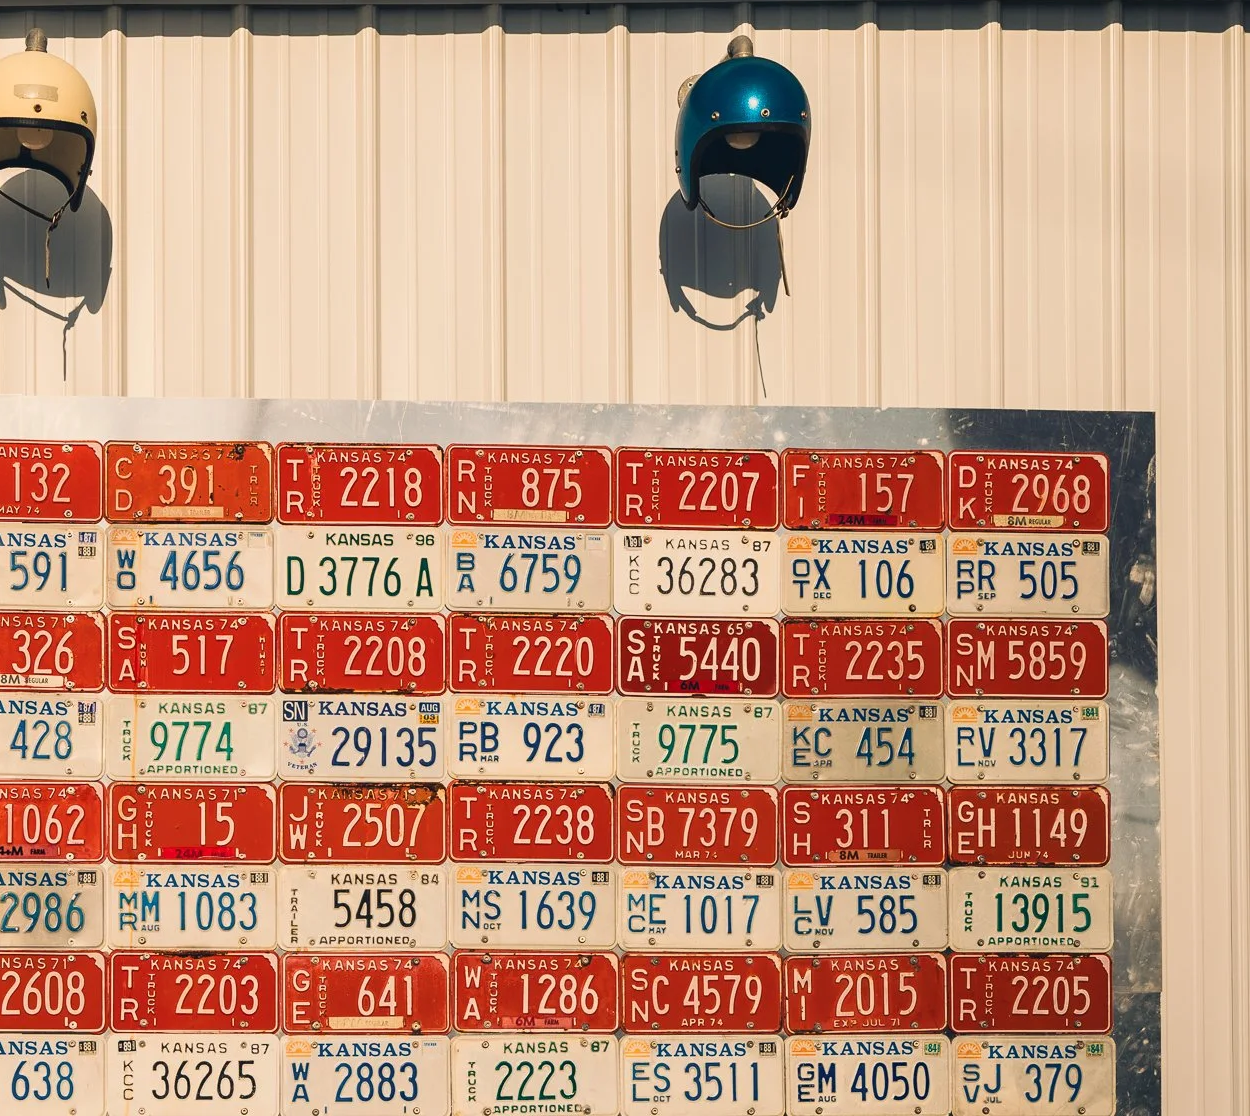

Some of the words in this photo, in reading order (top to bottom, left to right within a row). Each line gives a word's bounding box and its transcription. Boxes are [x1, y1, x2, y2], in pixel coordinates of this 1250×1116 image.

[158, 465, 214, 504] 391
[340, 468, 422, 507] 2218
[522, 468, 582, 508] 875
[679, 472, 760, 511] 2207
[859, 473, 914, 512] 157
[1011, 474, 1090, 514] 2968
[326, 534, 393, 545] KANSAS
[416, 535, 434, 545] 96
[1008, 517, 1026, 525] 8M
[160, 551, 244, 590] 4656
[287, 556, 305, 595] D
[319, 557, 400, 596] 3776
[416, 558, 433, 597] A
[500, 554, 581, 593] 6759
[657, 557, 759, 596] 36283
[12, 631, 74, 674] 326
[172, 635, 234, 675] 517
[344, 636, 426, 676] 2208
[513, 637, 593, 676] 2220
[679, 637, 760, 681] 5440
[846, 641, 925, 680] 2235
[159, 703, 225, 714] KANSAS
[248, 704, 267, 714] 87
[318, 701, 407, 716] KANSAS
[421, 704, 438, 712] AUG
[151, 721, 233, 761] 9774
[332, 727, 436, 767] 29135
[658, 725, 739, 763] 9775
[147, 765, 238, 774] APPORTIONED
[287, 761, 317, 770] VETERAN
[656, 768, 743, 777] APPORTIONED
[5, 803, 85, 845] 1062
[199, 802, 234, 845] 15
[343, 803, 426, 847] 2507
[513, 805, 594, 844] 2238
[836, 809, 889, 848] 311
[840, 851, 859, 860] 8M
[1009, 851, 1030, 859] JUN
[331, 874, 397, 885] KANSAS
[421, 874, 439, 885] 84
[1000, 876, 1062, 888] KANSAS
[1081, 877, 1098, 888] 91
[334, 889, 416, 928] 5458
[995, 893, 1092, 933] 13915
[320, 936, 409, 945] APPORTIONED
[988, 937, 1074, 946] APPORTIONED
[2, 971, 84, 1015] 2608
[176, 975, 258, 1014] 2203
[357, 976, 413, 1016] 641
[520, 974, 598, 1015] 1286
[835, 973, 917, 1017] 2015
[1011, 976, 1090, 1015] 2205
[988, 1045, 1076, 1059] KANSAS
[152, 1060, 256, 1101] 36265
[335, 1062, 418, 1103] 2883
[495, 1060, 577, 1101] 2223
